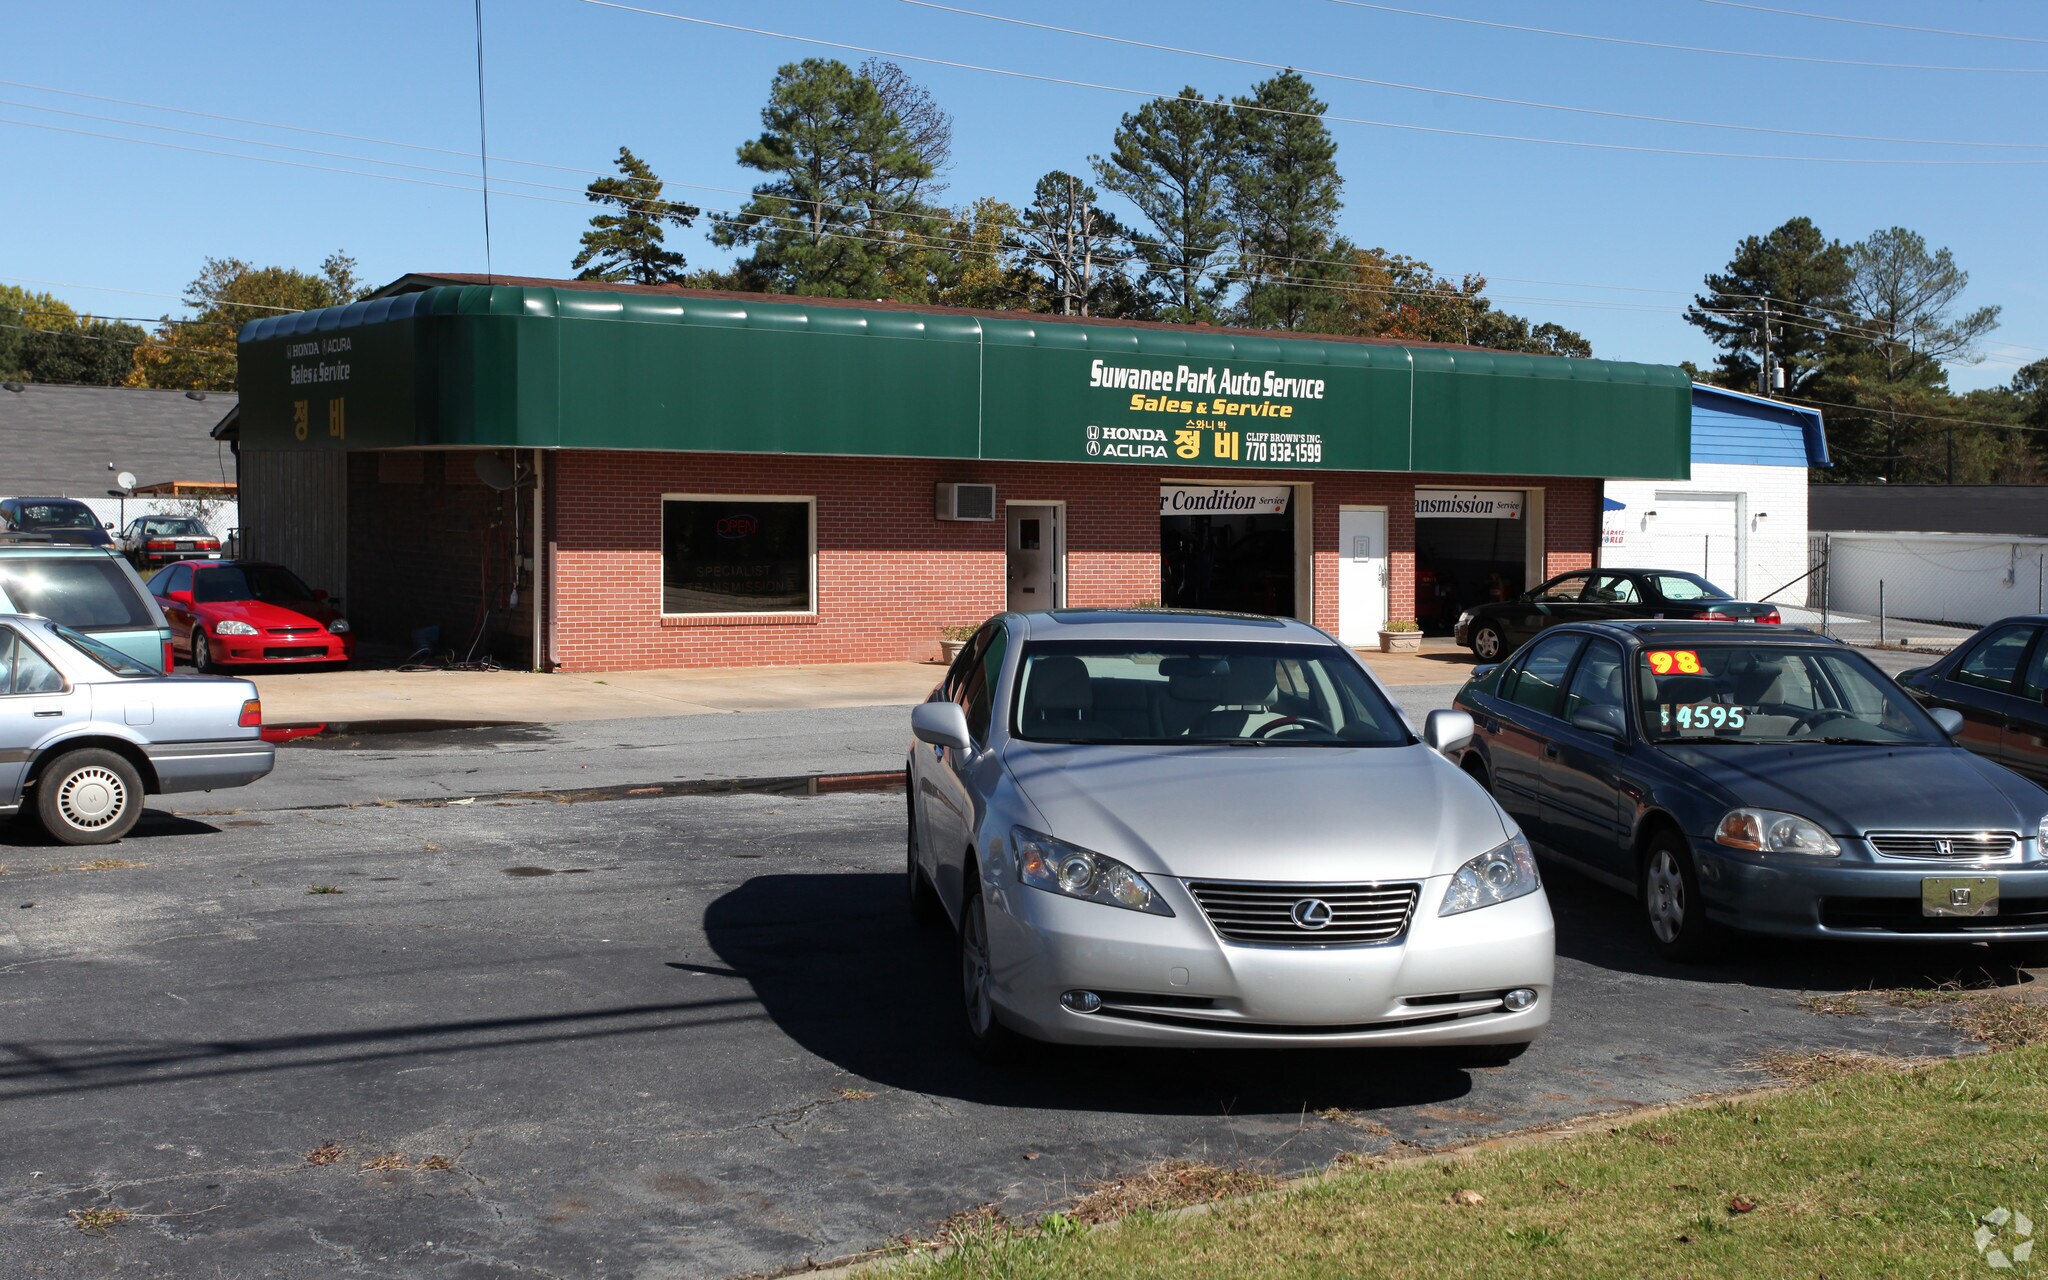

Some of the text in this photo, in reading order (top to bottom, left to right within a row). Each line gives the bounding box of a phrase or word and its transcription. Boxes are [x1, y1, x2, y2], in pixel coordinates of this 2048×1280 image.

[292, 337, 352, 357] HONDA ACURA
[291, 364, 312, 385] Sales
[319, 360, 351, 382] Service
[1090, 359, 1325, 399] Suwanee Park Auto Service
[1129, 393, 1293, 418] Sales & Service
[1185, 419, 1215, 431] 스와니
[1102, 427, 1168, 442] HONDA
[1246, 432, 1323, 444] CLIFF BROWN'S INC.
[1102, 443, 1169, 458] ACURA
[1245, 442, 1322, 463] 770 932-1599
[1172, 489, 1256, 511] Condition
[1258, 496, 1285, 505] Service
[1496, 501, 1520, 510] Service
[716, 519, 757, 534] OPEN
[1602, 536, 1624, 544] ORLD
[696, 565, 771, 577] SPECIALIST
[688, 580, 784, 593] TRANSMISSION
[1649, 651, 1700, 674] 98
[1676, 705, 1745, 729] 4595
